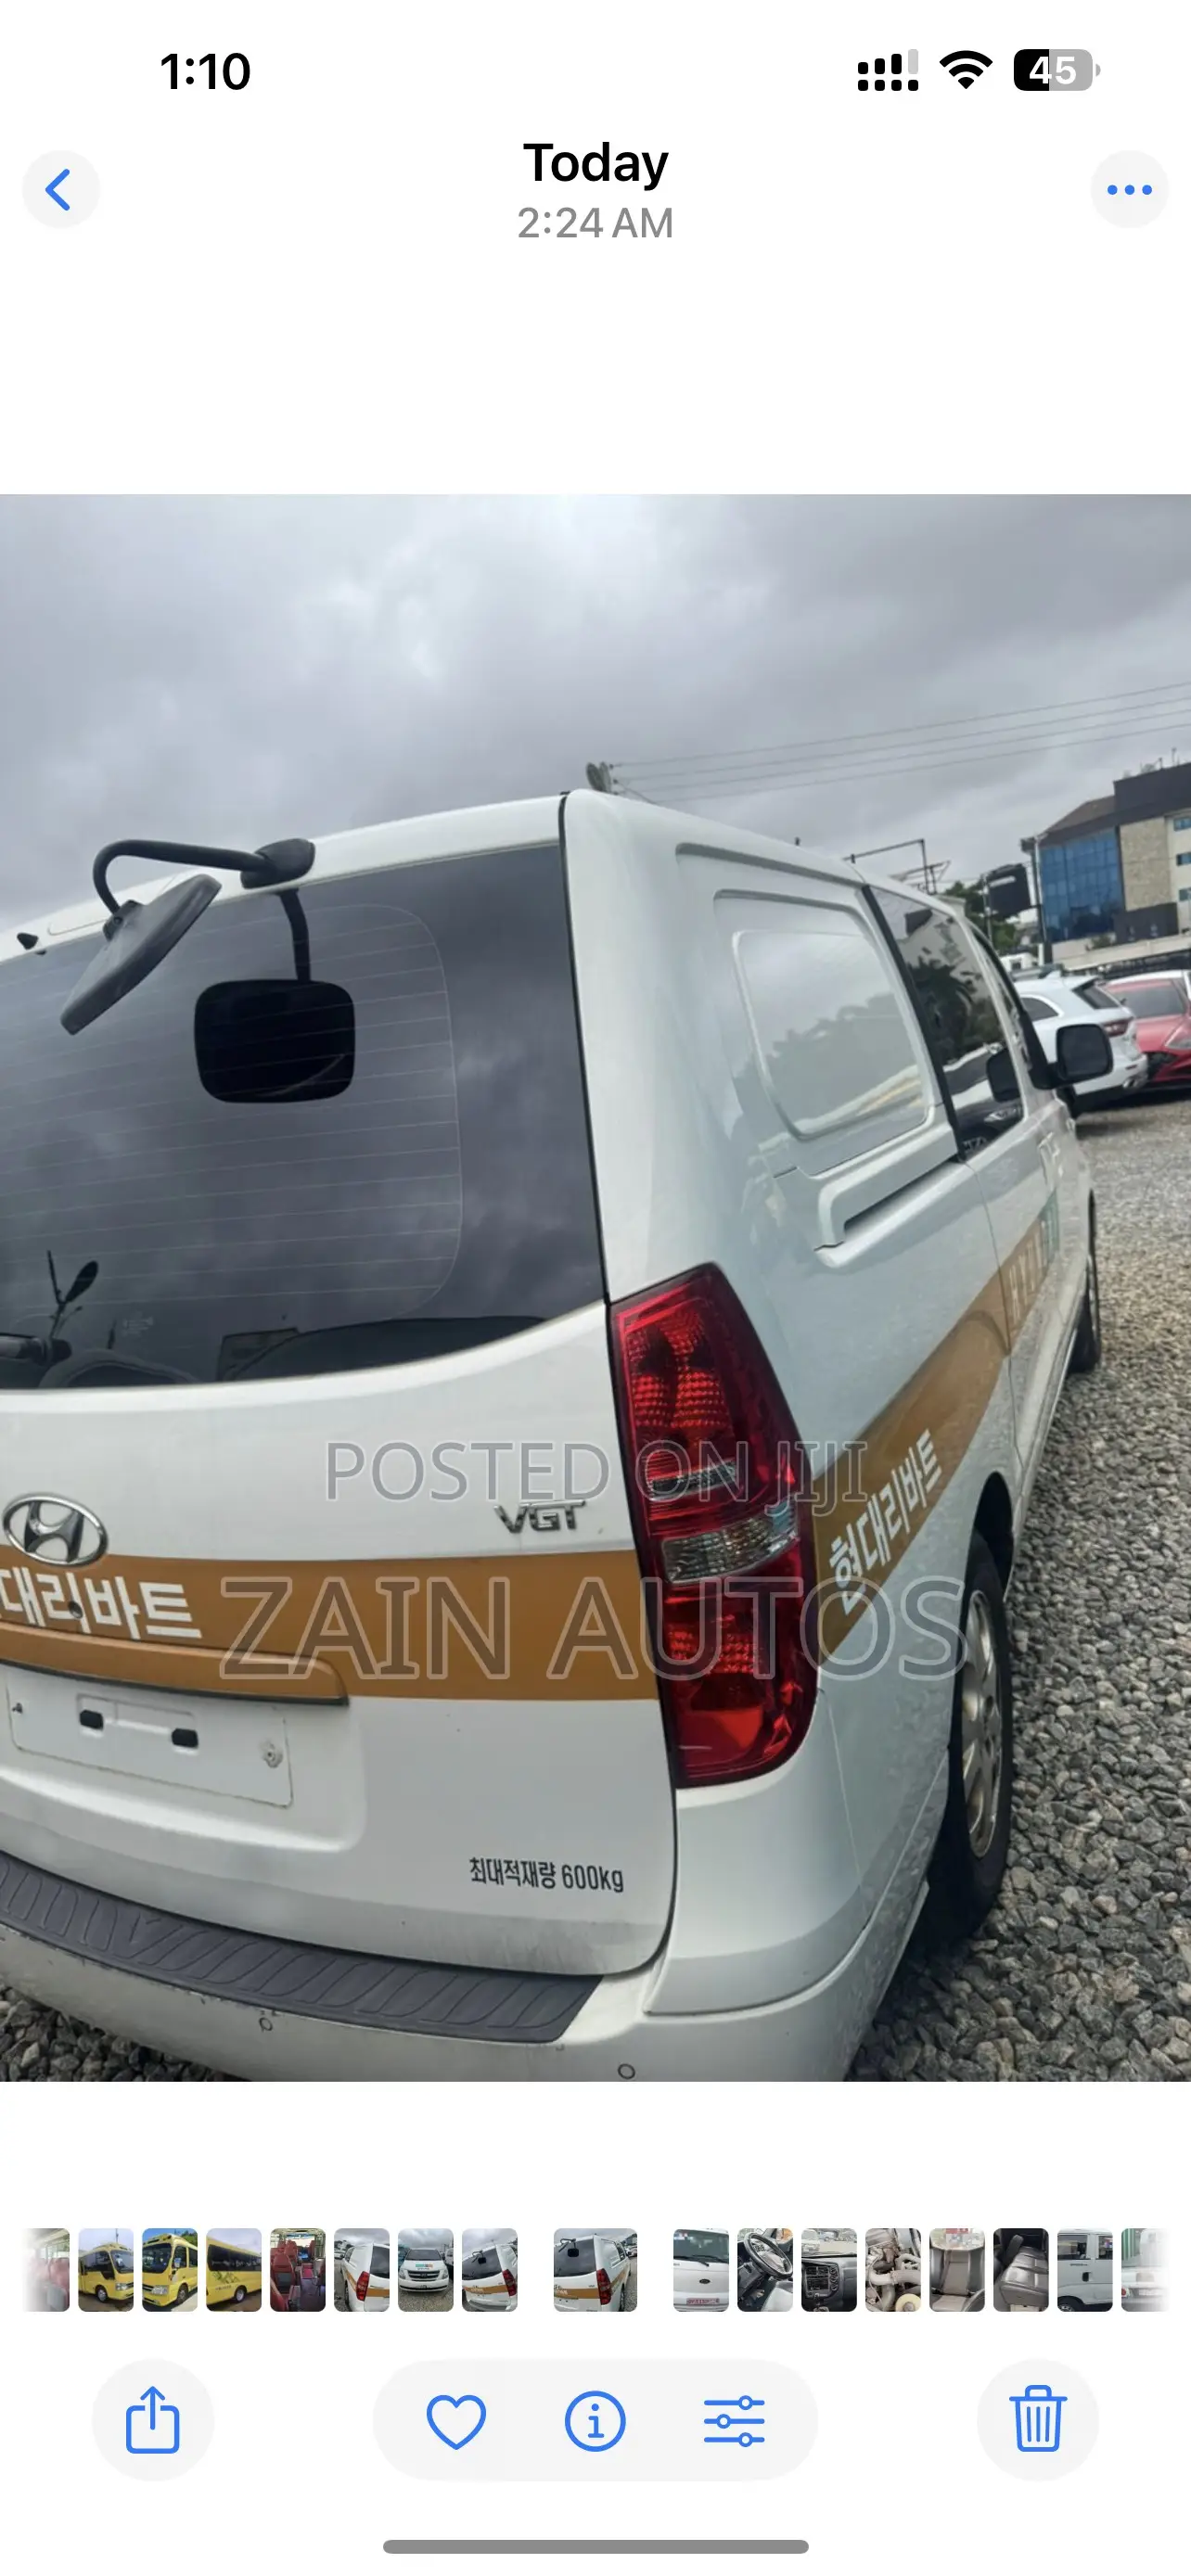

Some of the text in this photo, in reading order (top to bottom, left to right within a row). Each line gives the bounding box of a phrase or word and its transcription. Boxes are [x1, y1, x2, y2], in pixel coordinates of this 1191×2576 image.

[160, 52, 251, 91] 1:10
[1029, 56, 1077, 85] 45
[522, 141, 670, 192] Today
[518, 206, 672, 238] 2:24 AM
[493, 1499, 586, 1534] VGT
[829, 1428, 942, 1616] 현대리바트
[0, 1566, 203, 1640] 대리바트
[469, 1856, 624, 1894] 최대적재량 600kg
